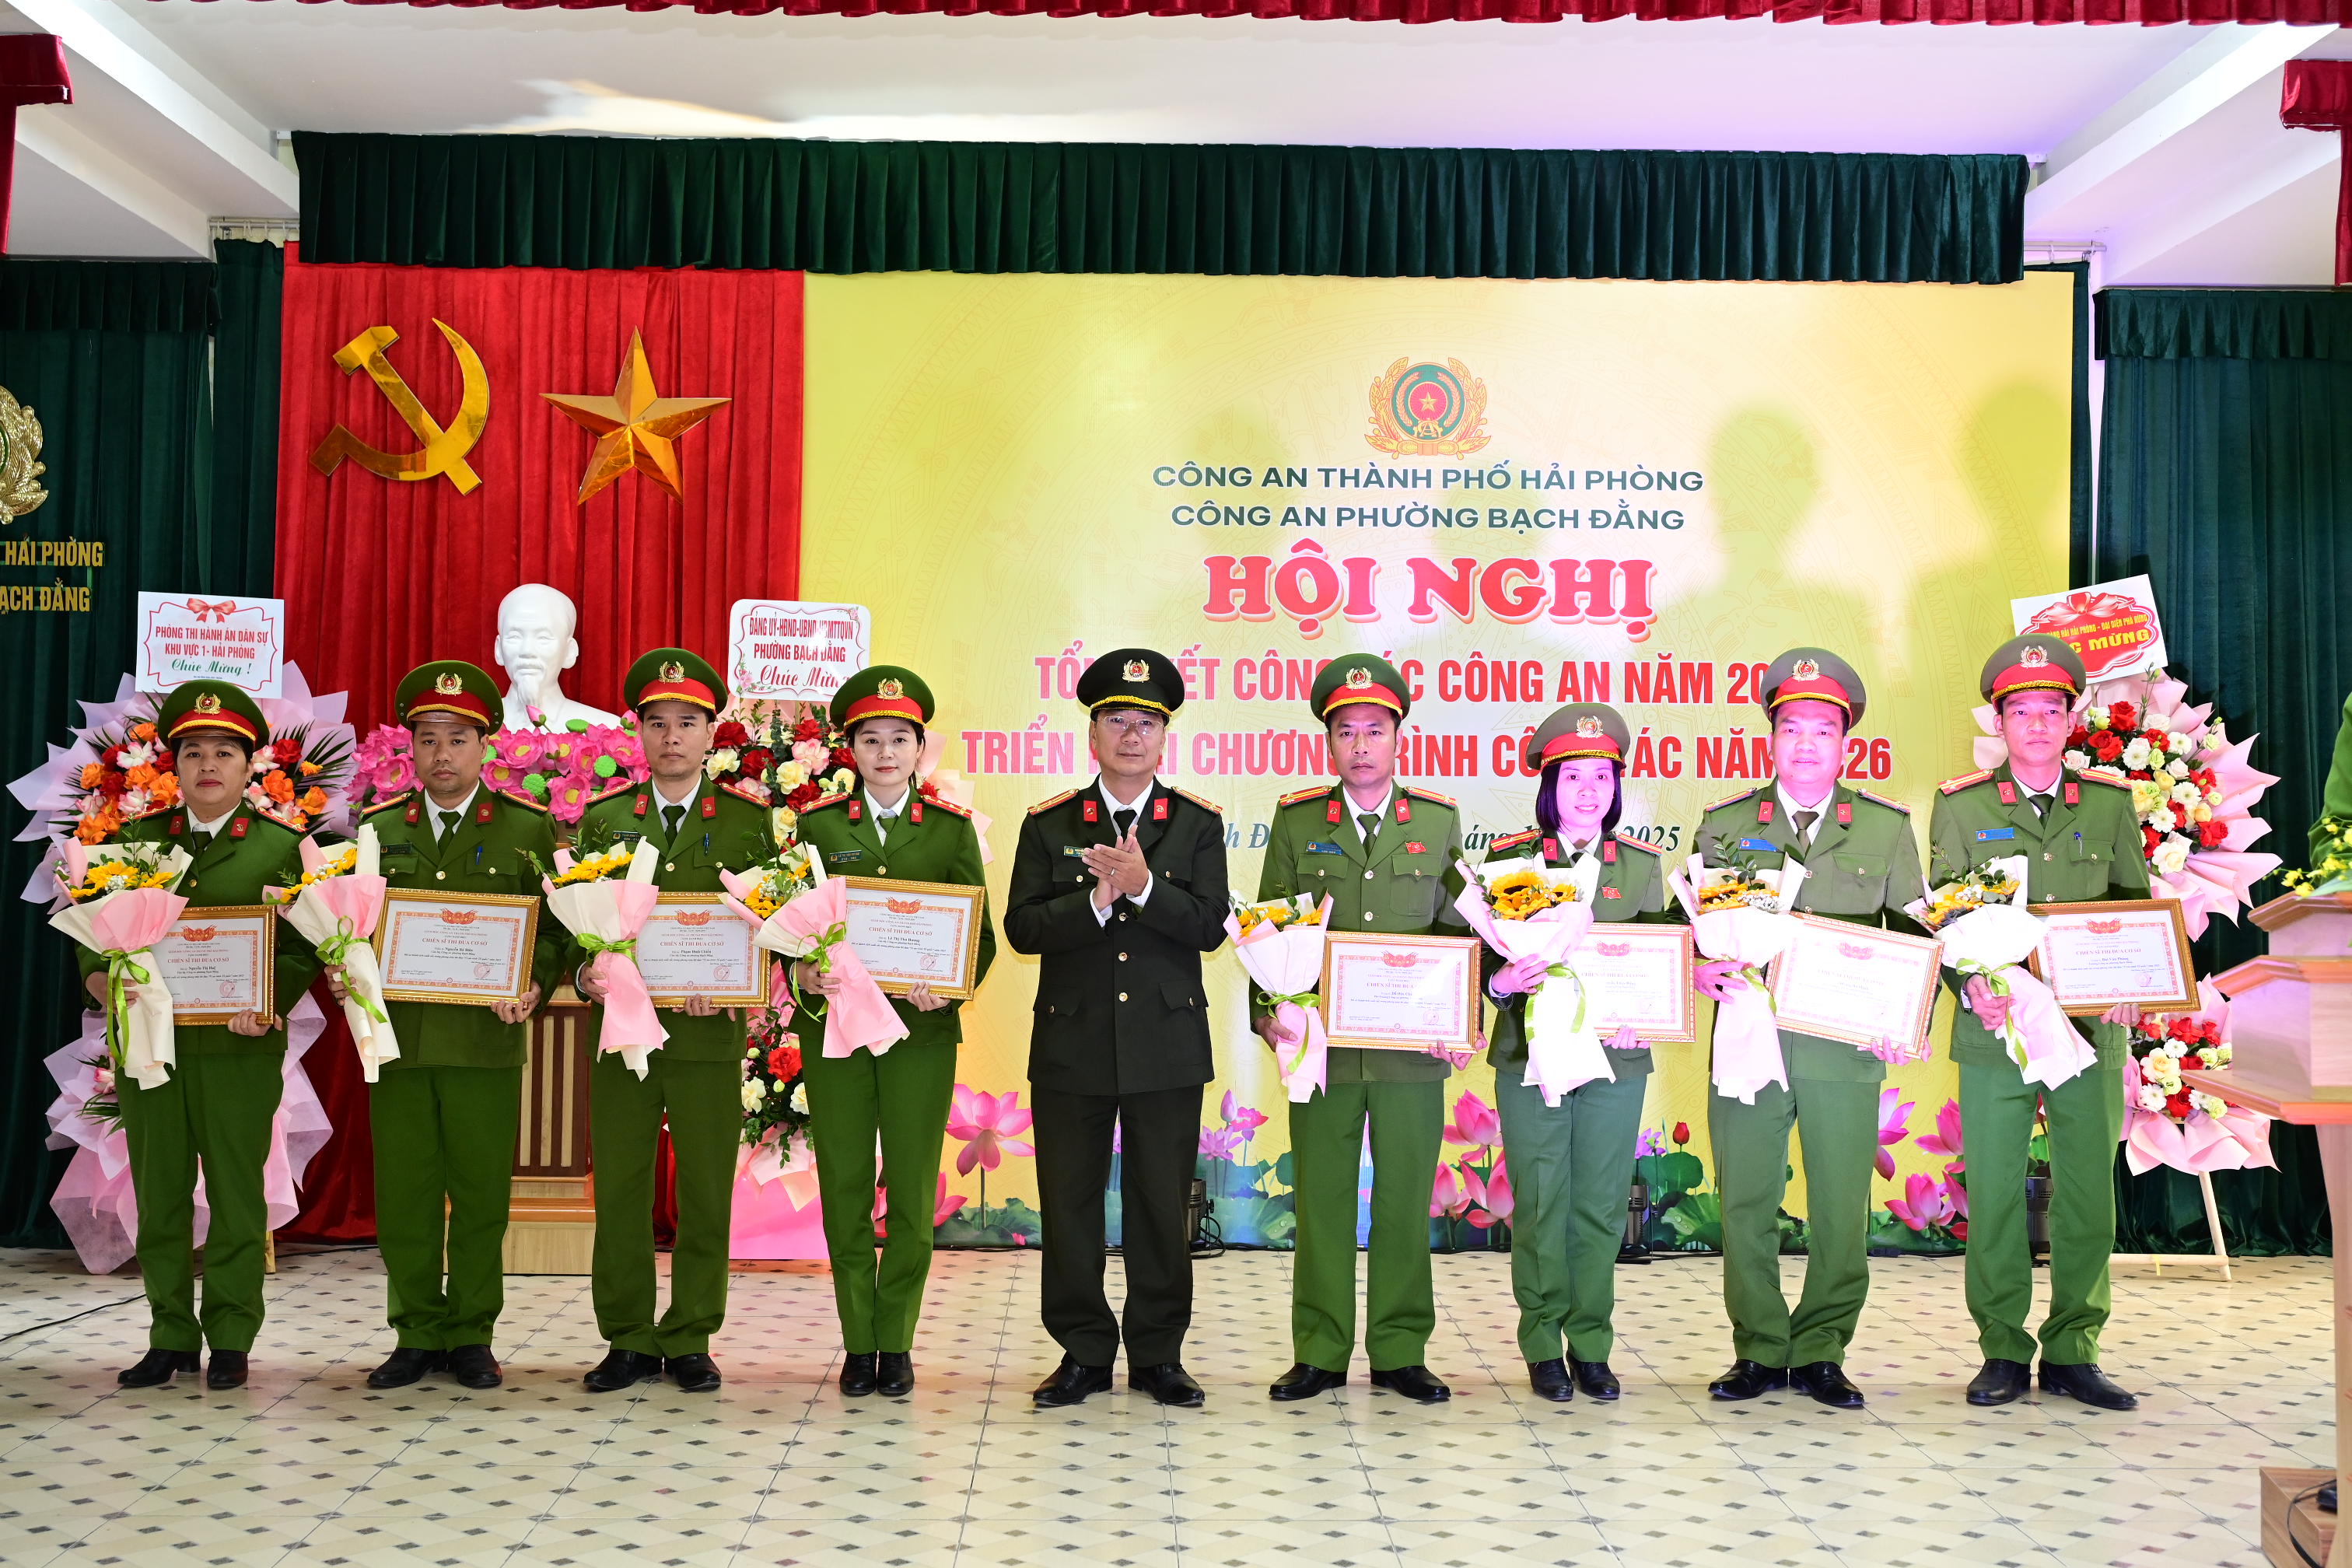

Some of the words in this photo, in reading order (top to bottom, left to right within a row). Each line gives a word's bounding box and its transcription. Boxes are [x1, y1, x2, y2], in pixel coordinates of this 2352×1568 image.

[1153, 460, 1252, 488] CÔNG
[1261, 467, 1308, 488] AN
[1317, 462, 1433, 489] THÀNH
[1442, 459, 1511, 490] PHỐ
[1520, 462, 1575, 491] HẢI
[1585, 464, 1703, 492] PHÒNG
[1171, 499, 1272, 527] CÔNG
[1279, 506, 1327, 527] AN
[1336, 501, 1479, 528] PHƯỜNG
[1487, 508, 1580, 534] BẠCH
[1588, 499, 1685, 530] ĐẰNG
[42, 536, 104, 567] PHÒNG
[0, 586, 33, 614] ẠCH
[1203, 537, 1381, 640] HỘI
[1405, 557, 1658, 643] NGHỊ
[156, 624, 183, 639] PHÒNG
[186, 628, 198, 639] THI
[200, 626, 222, 641] HÀNH
[225, 627, 236, 642] ÁN
[238, 628, 255, 643] DÂN
[257, 631, 269, 646] SỰ
[2088, 628, 2150, 651] MỪNG
[165, 643, 181, 656] KHU
[184, 643, 199, 659] VỰC
[212, 642, 226, 657] HẢI
[228, 644, 255, 660] PHÒNG
[754, 639, 791, 660] PHƯỜNG
[171, 658, 202, 672] Chúc
[205, 660, 242, 677] Mừng
[760, 664, 799, 686] Chúc
[802, 667, 850, 688] Mừn
[1035, 640, 1098, 699] TỔ
[1172, 644, 1220, 700] ẾT
[1438, 651, 1544, 703] CÔNG
[1556, 660, 1610, 703] AN
[1625, 653, 1713, 704] NĂM
[1727, 662, 1771, 704] 20
[961, 713, 1073, 775] TRIỂN
[1392, 725, 1479, 777] RÌNH
[1620, 726, 1682, 779] ÁC
[1837, 737, 1892, 781] 26
